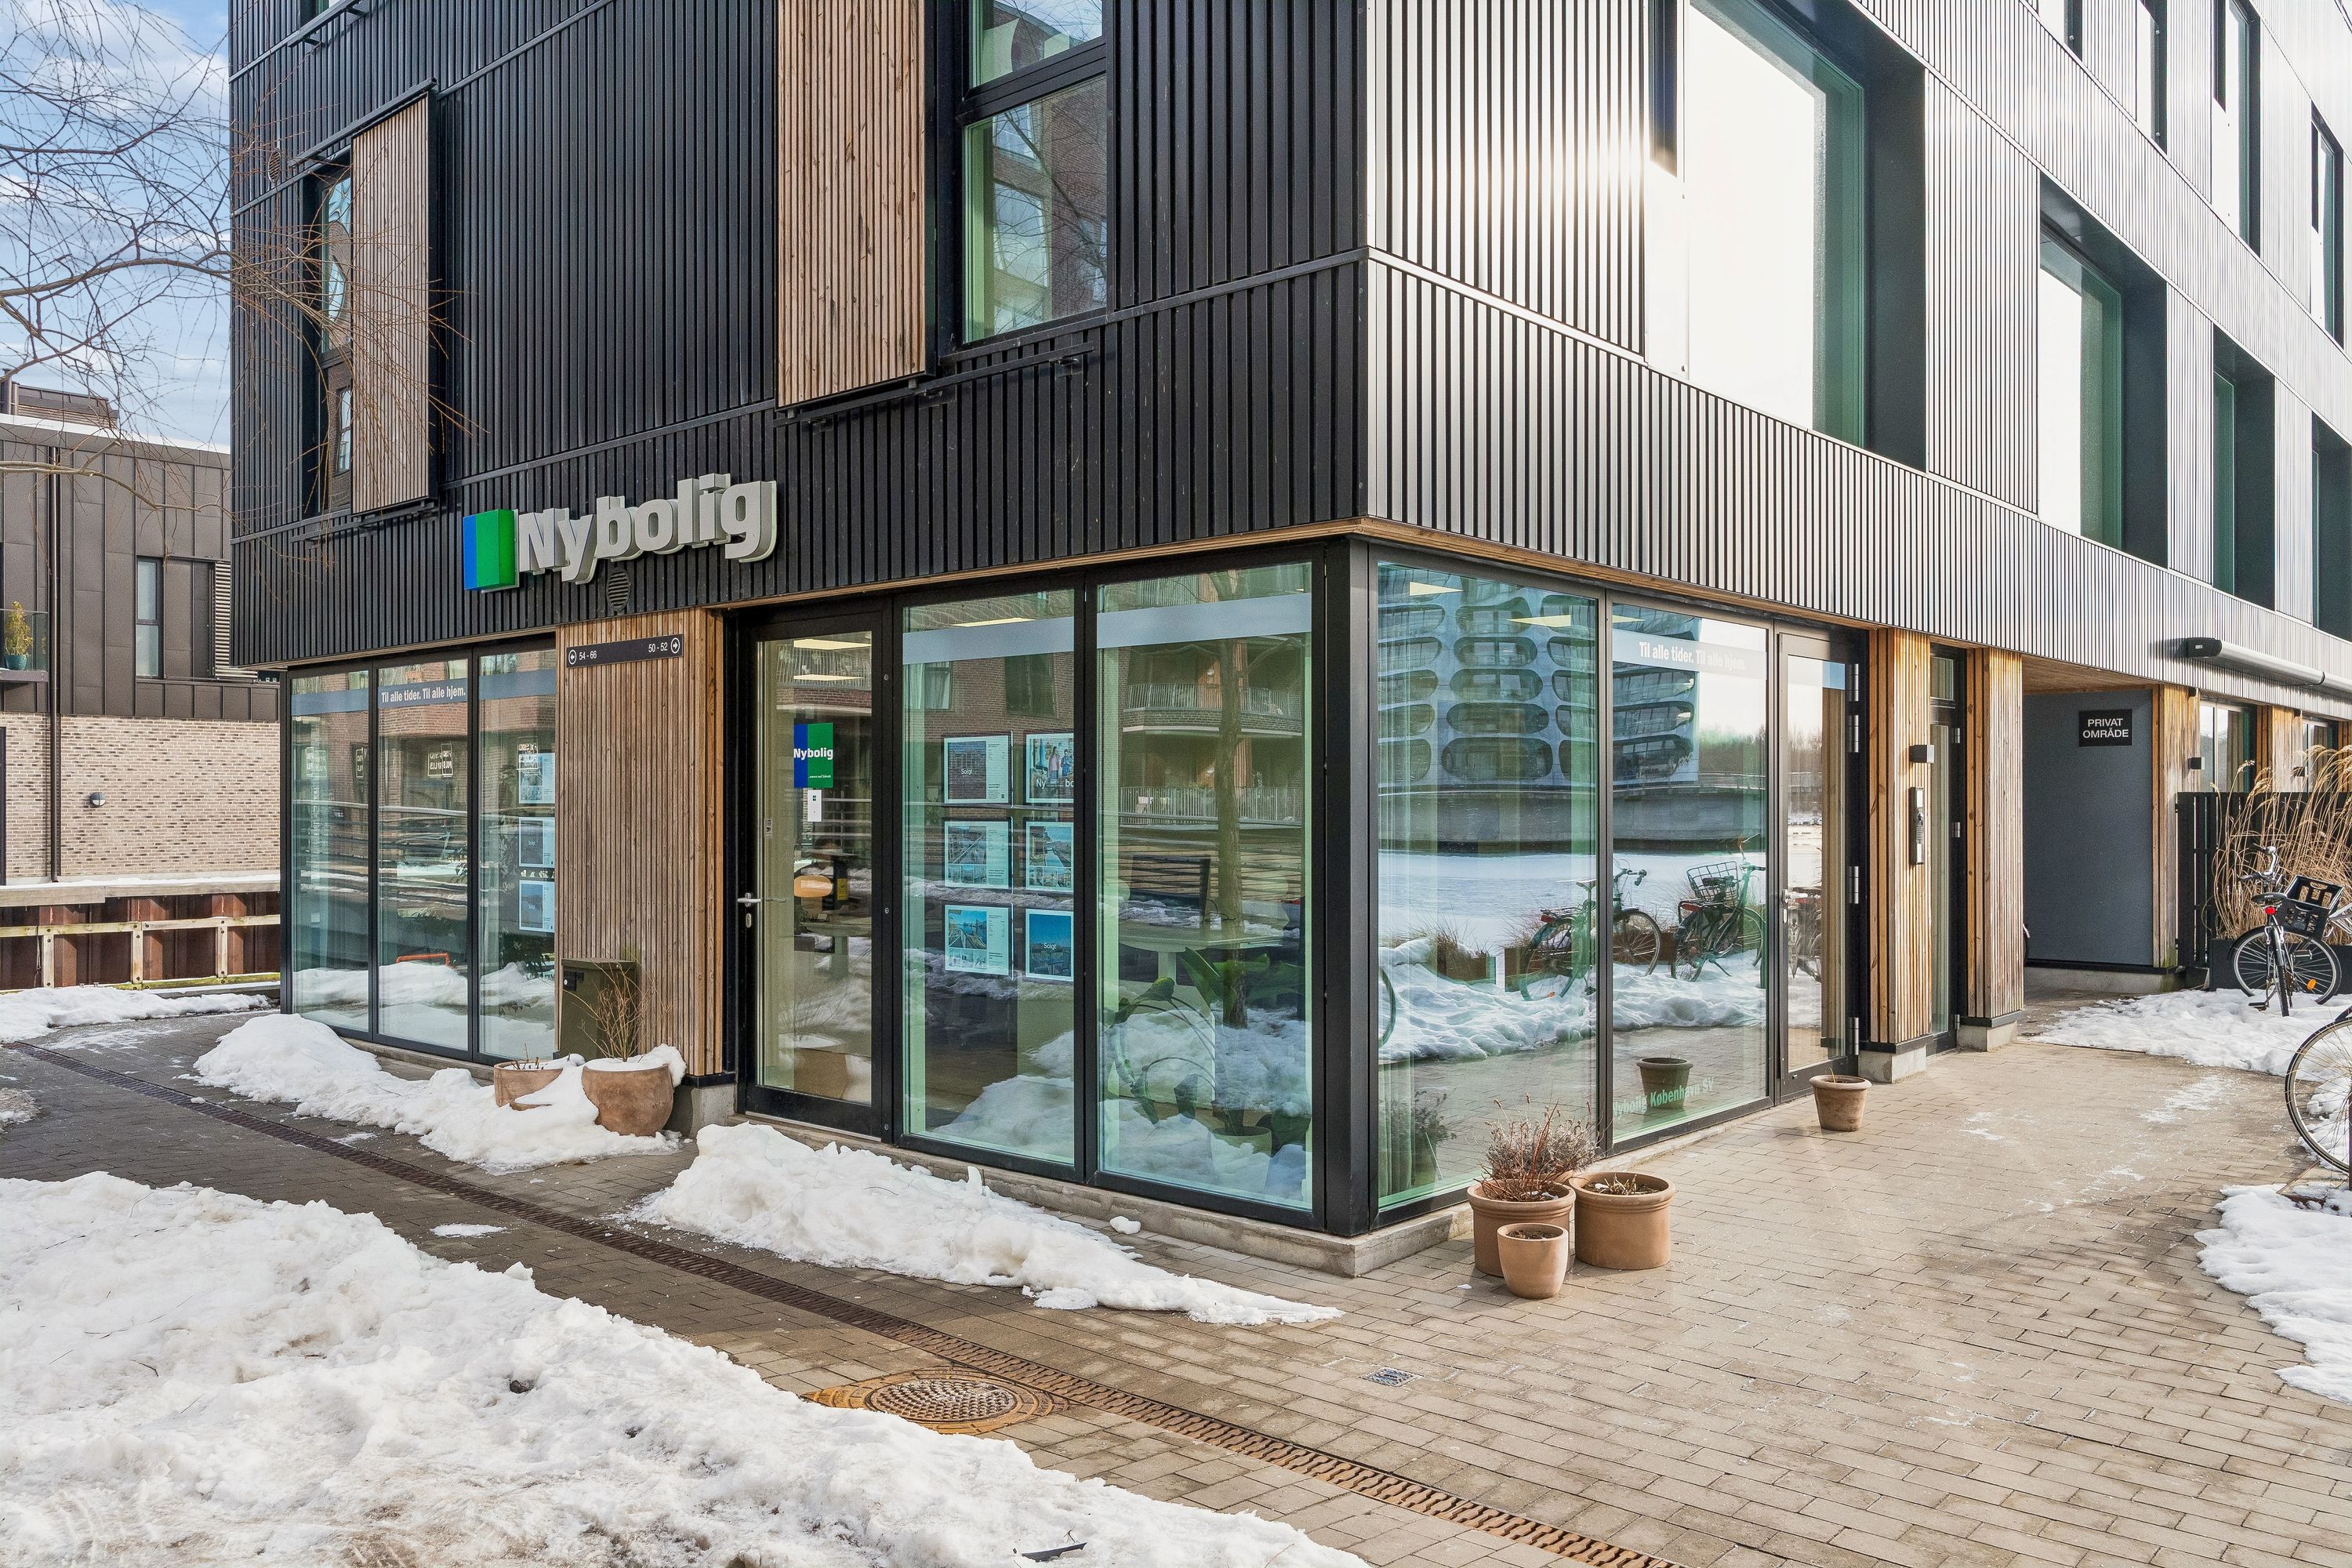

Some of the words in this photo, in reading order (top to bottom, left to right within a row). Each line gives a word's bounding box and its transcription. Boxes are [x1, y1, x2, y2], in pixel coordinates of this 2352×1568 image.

[518, 473, 778, 585] Nybolig
[648, 643, 656, 653] 50
[660, 642, 668, 652] 52
[579, 652, 586, 661] 54
[590, 650, 597, 660] 66
[1639, 641, 1650, 658] Til
[1652, 644, 1669, 660] alle
[1671, 646, 1693, 663] tider.
[1696, 649, 1706, 666] Til
[1708, 651, 1723, 667] alle
[390, 691, 403, 702] alle
[404, 689, 421, 701] tider.
[432, 687, 445, 699] alle
[446, 685, 466, 699] hjem.
[2088, 718, 2123, 728] PRIVAT
[2082, 728, 2129, 739] OMRÅDE
[793, 747, 833, 760] Nybolig
[1036, 779, 1046, 789] Ny
[1650, 1083, 1700, 1108] København
